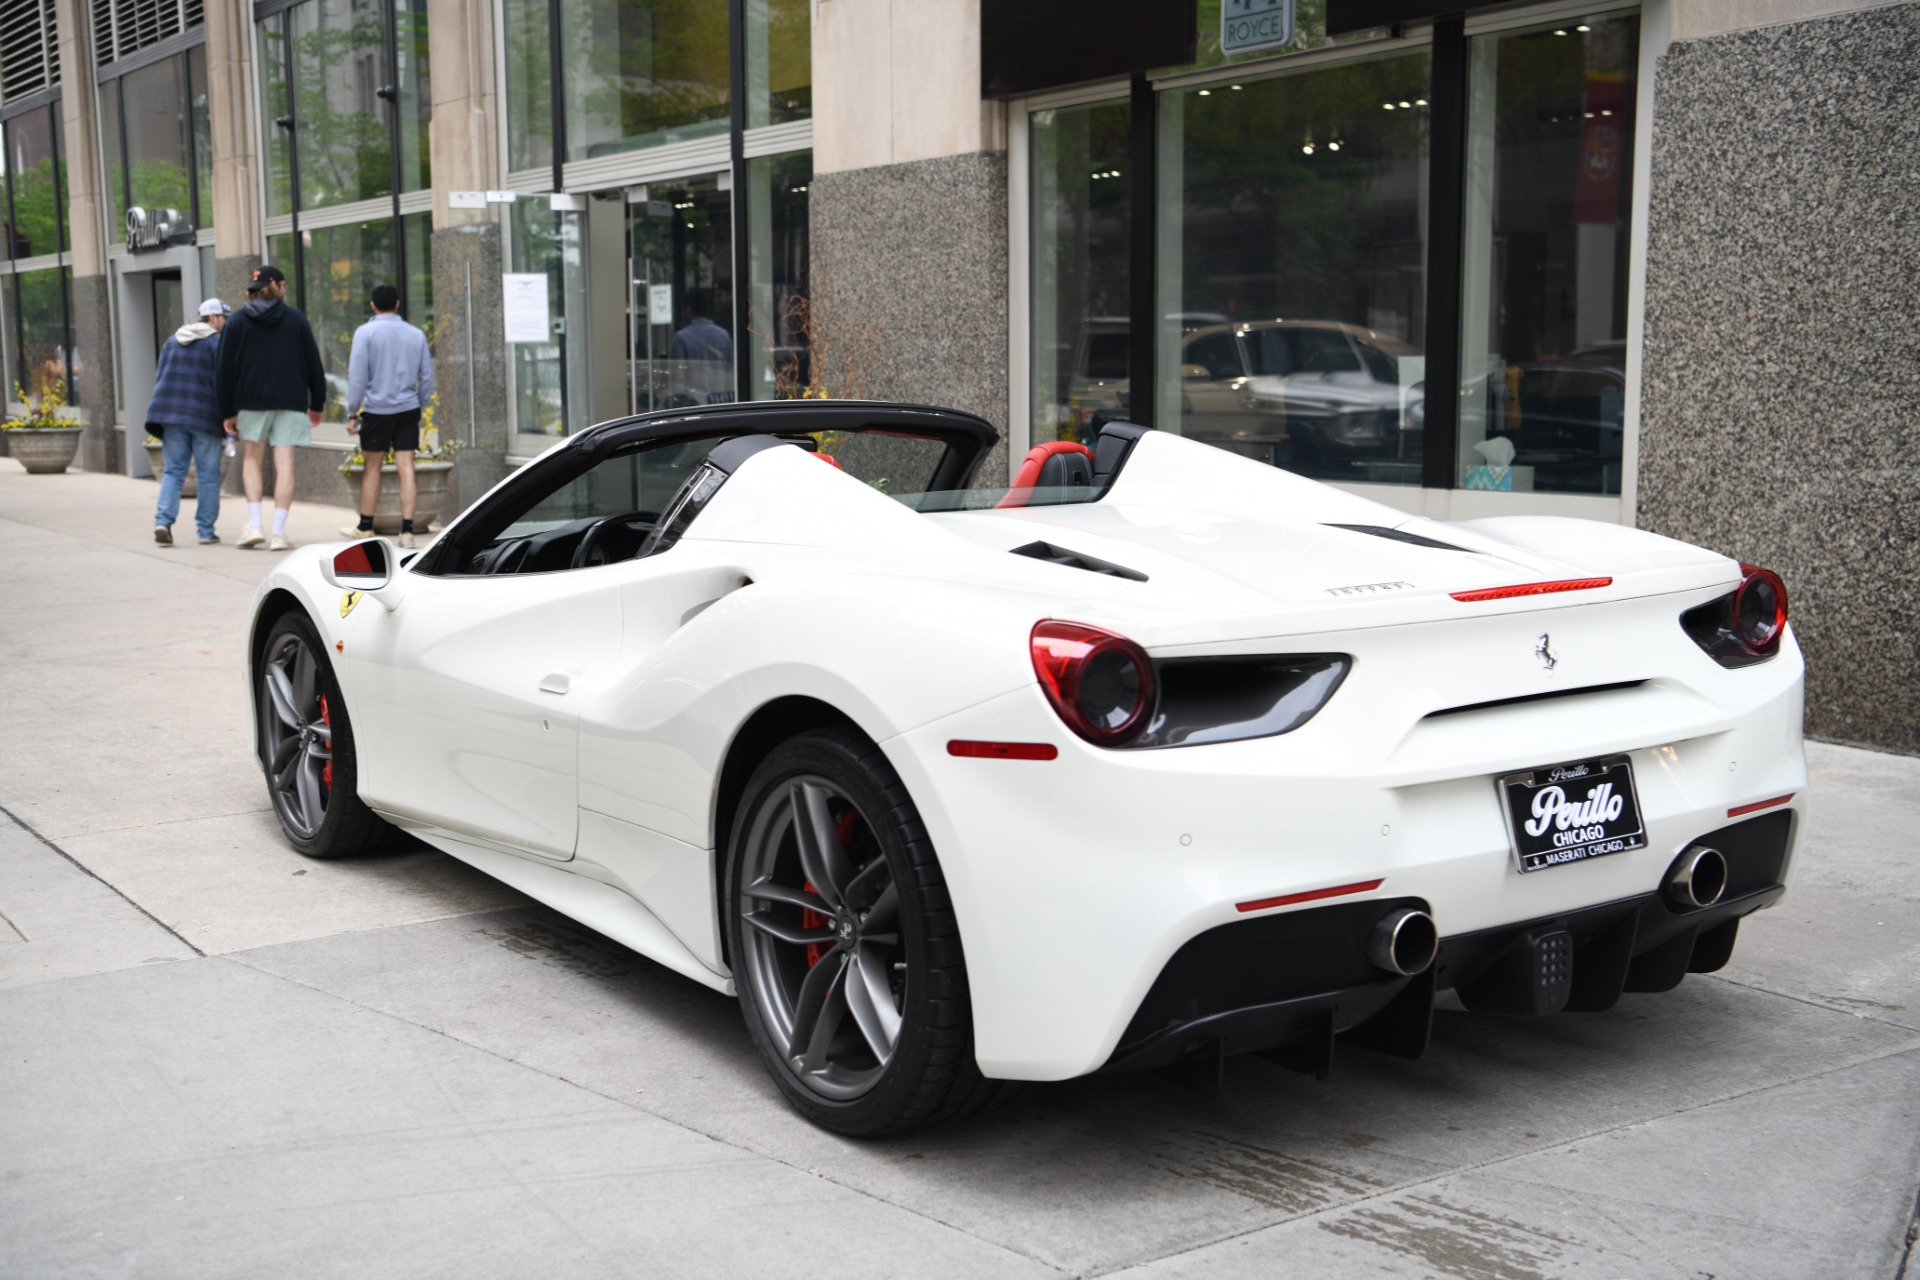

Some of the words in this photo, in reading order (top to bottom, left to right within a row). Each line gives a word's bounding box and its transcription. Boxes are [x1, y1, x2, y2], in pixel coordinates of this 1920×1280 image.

[1228, 15, 1279, 43] ROYCE
[1548, 764, 1589, 782] Perillo
[1524, 782, 1623, 837] Perillo
[1553, 825, 1605, 847] CHICAGO
[1546, 848, 1587, 866] MASERATI
[1588, 840, 1624, 856] CHICAGO
